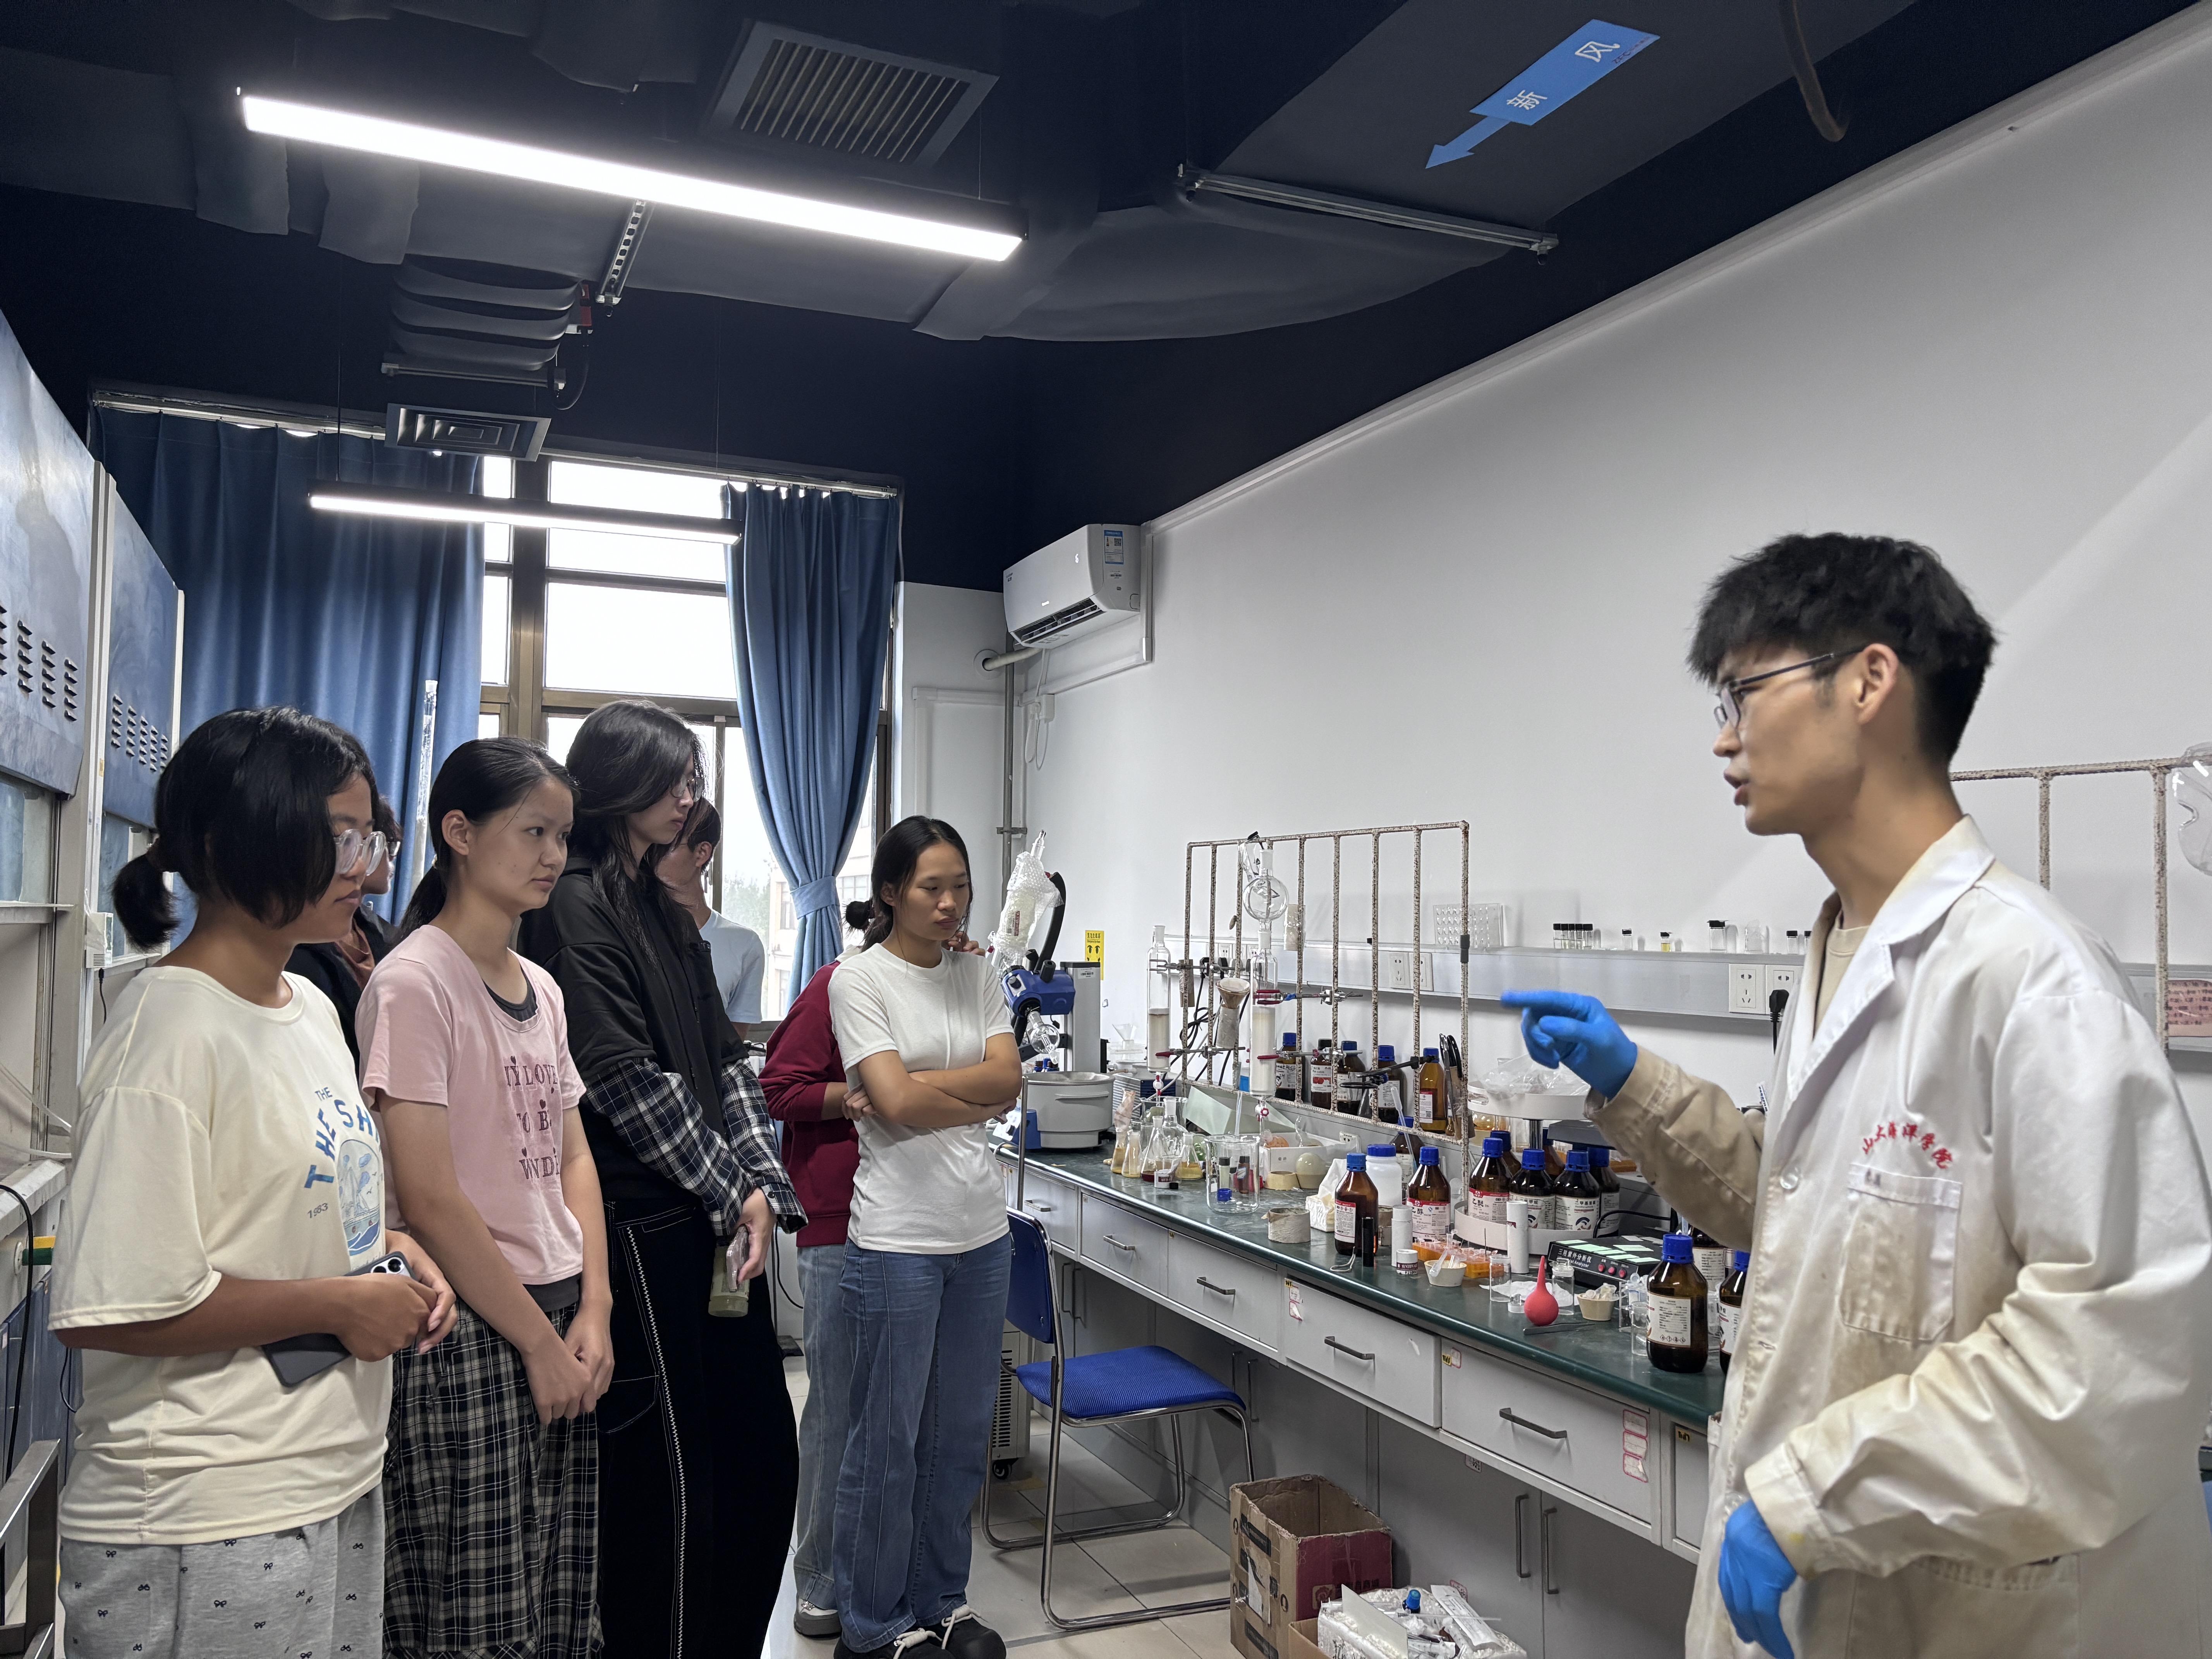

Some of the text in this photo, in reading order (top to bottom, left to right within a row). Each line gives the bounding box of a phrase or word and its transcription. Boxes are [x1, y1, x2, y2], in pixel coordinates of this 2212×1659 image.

[315, 1087, 333, 1101] THE
[334, 1099, 381, 1152] SH
[307, 1202, 328, 1219] 1983
